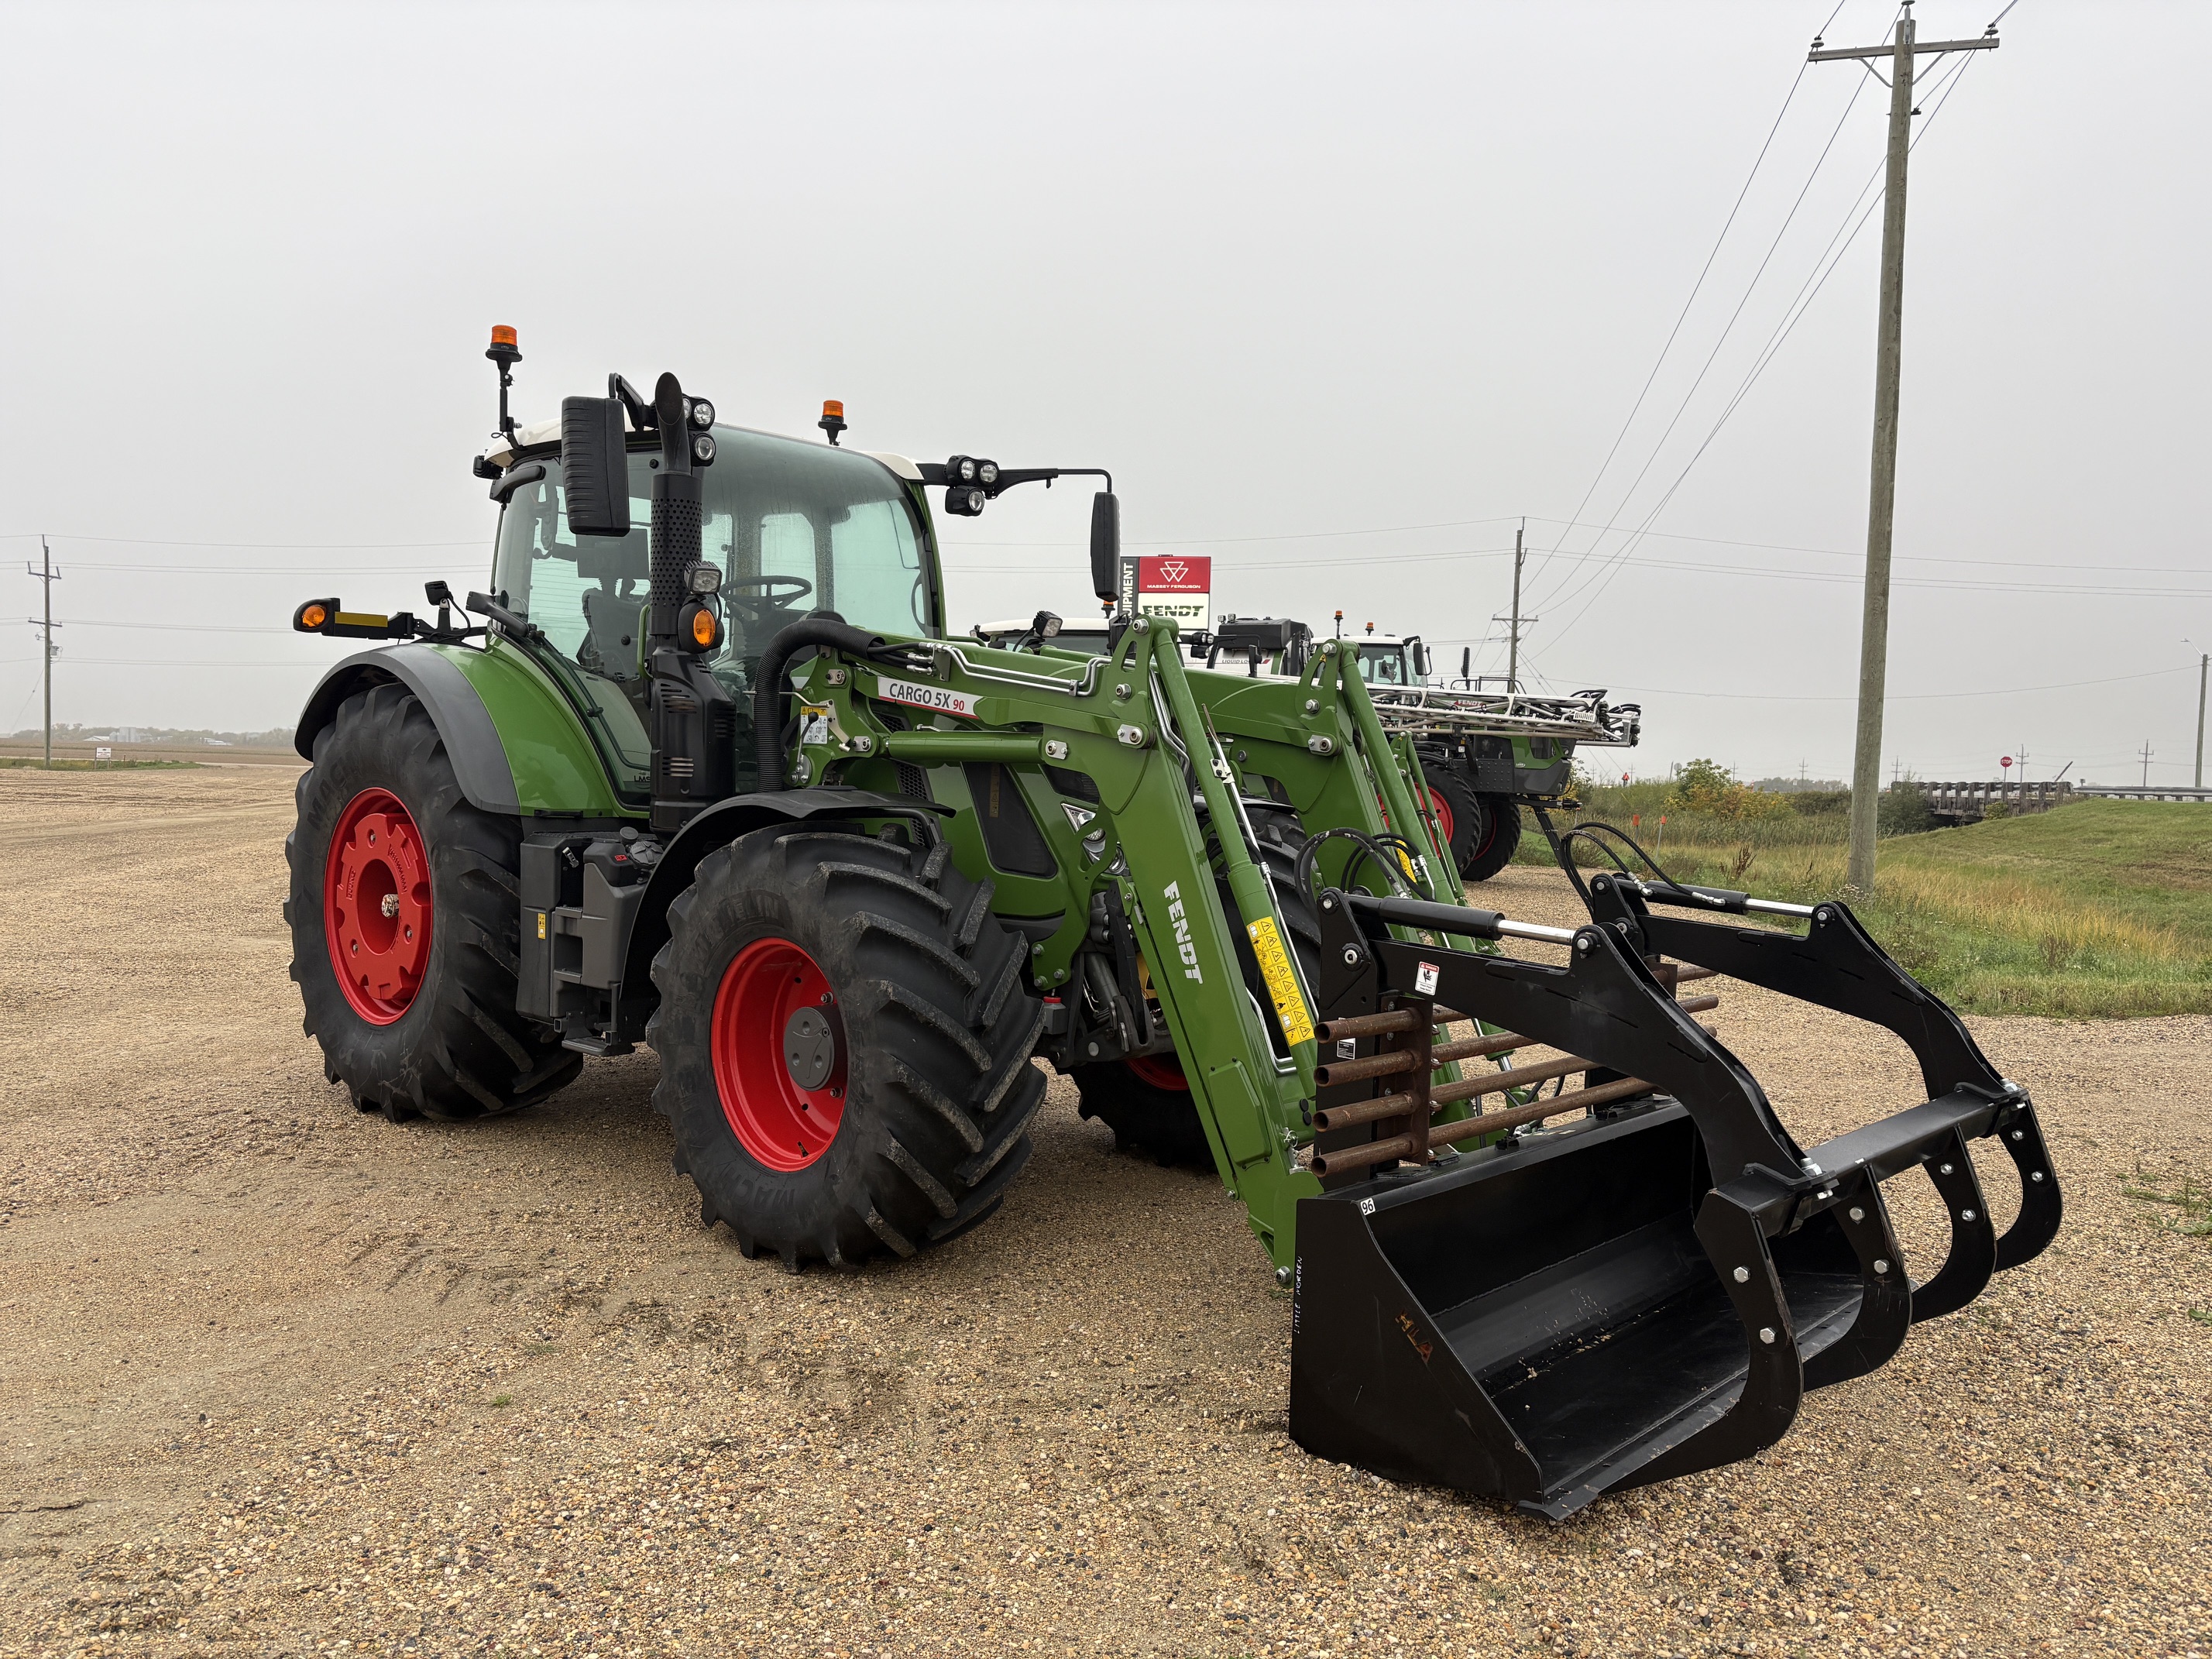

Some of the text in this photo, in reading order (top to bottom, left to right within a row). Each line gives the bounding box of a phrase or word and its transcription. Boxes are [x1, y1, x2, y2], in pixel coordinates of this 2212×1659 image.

[1122, 562, 1134, 619] UIPMENT
[1142, 606, 1204, 617] FENDT
[889, 683, 965, 712] CARGO 5X 90
[1163, 880, 1203, 984] FENDT
[1362, 1199, 1374, 1214] 96
